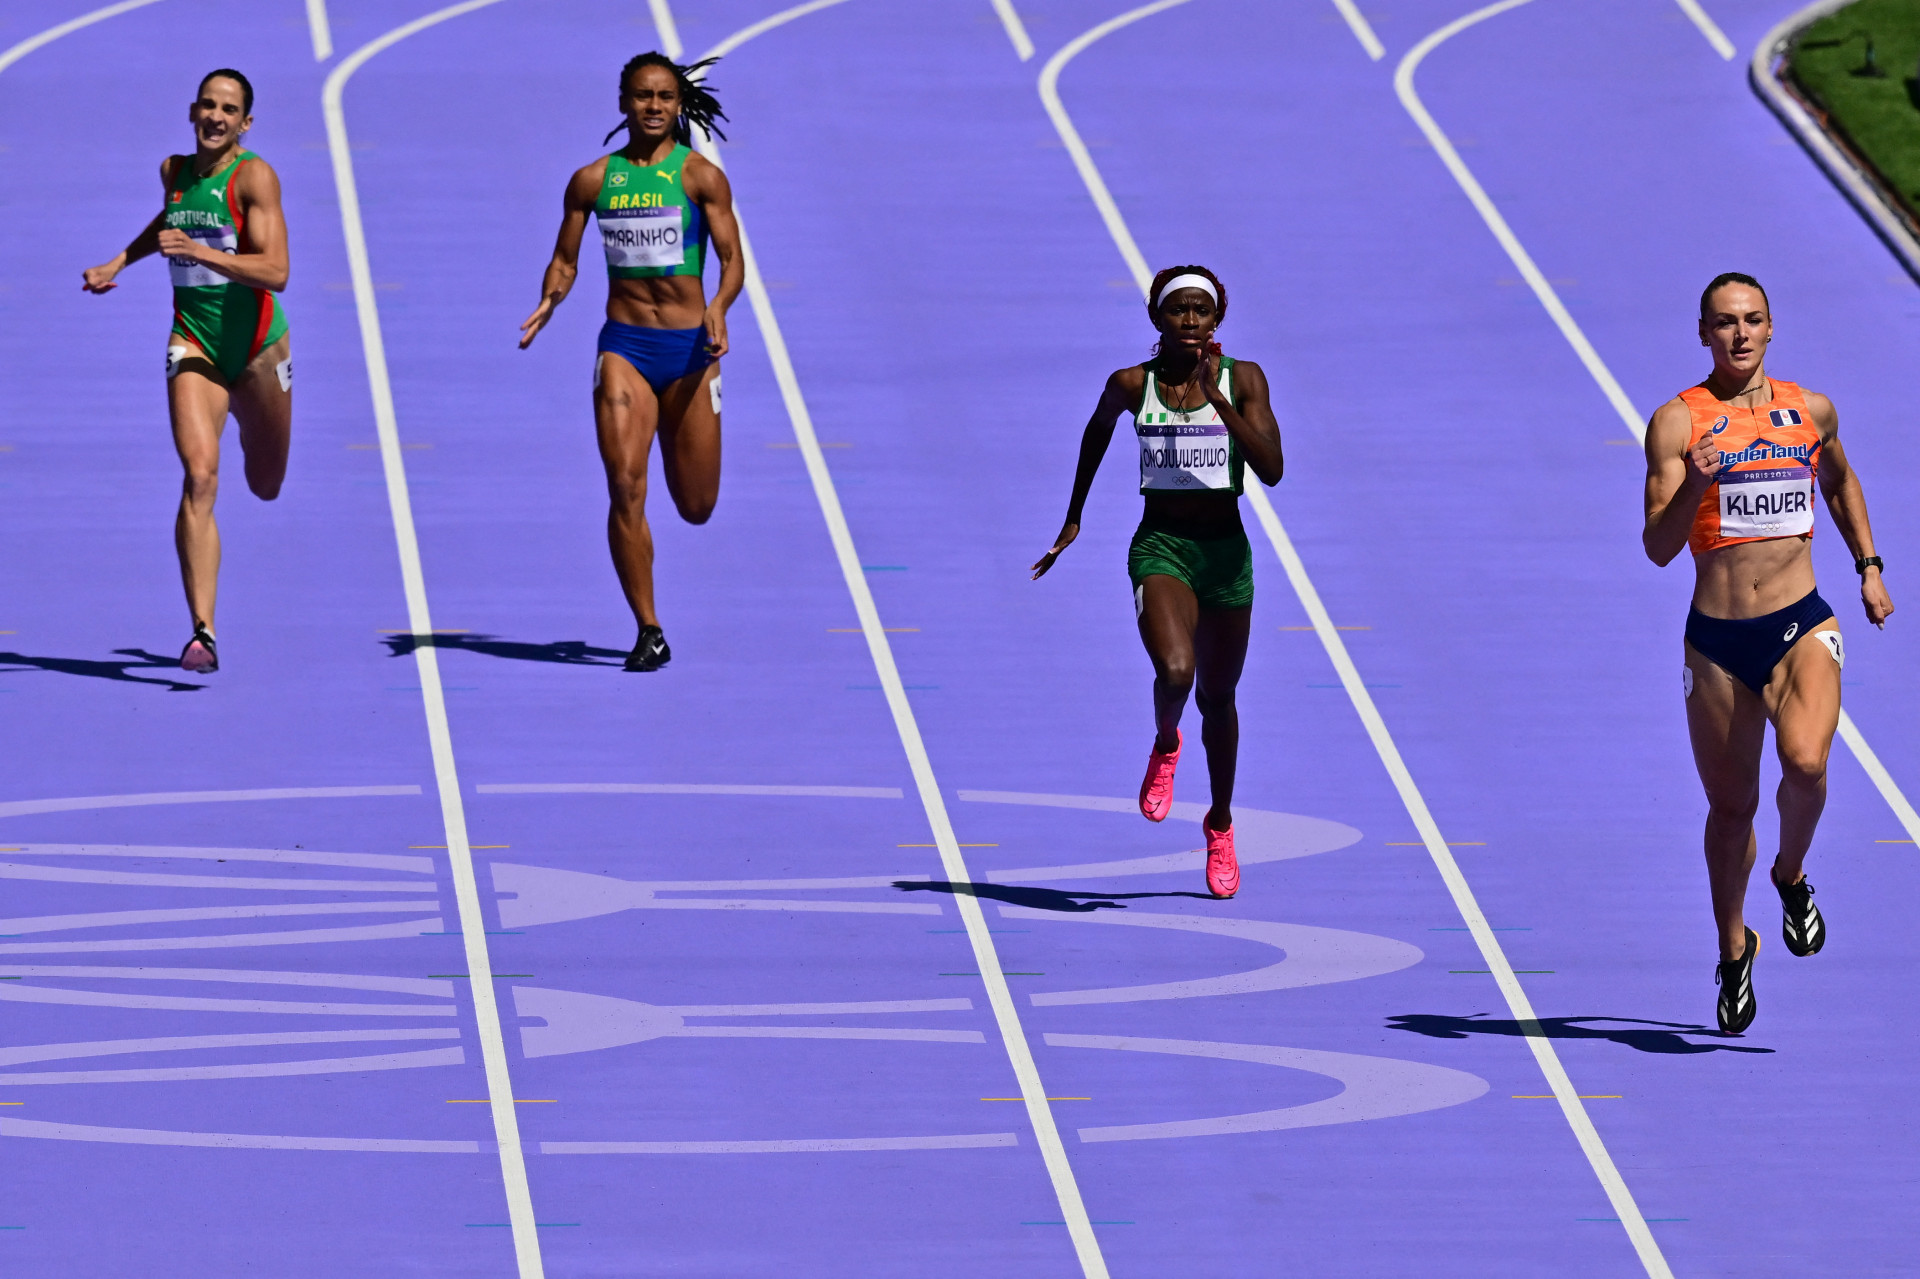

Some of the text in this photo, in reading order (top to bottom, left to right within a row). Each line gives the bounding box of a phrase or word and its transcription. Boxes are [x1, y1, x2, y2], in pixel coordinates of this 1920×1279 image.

[609, 193, 664, 210] BRASIL
[166, 210, 224, 228] PORTUGAL
[603, 227, 678, 248] MARINHO
[1744, 470, 1792, 480] PARIS 2024
[1726, 491, 1807, 516] KLAVER
